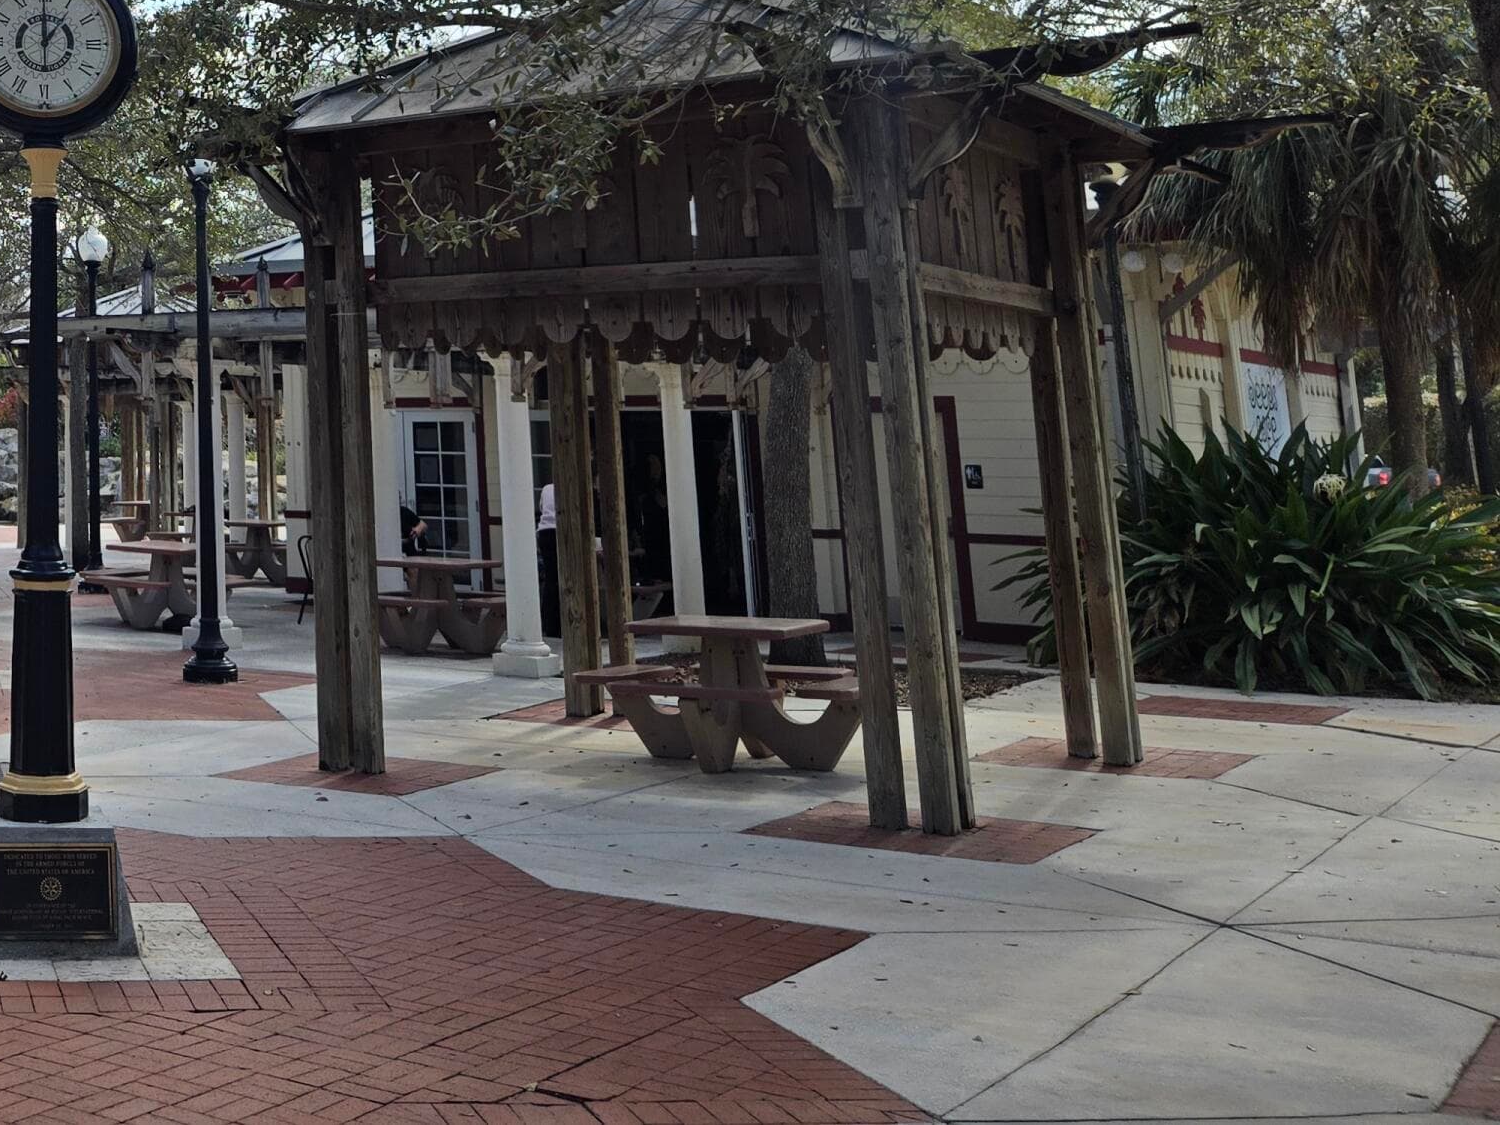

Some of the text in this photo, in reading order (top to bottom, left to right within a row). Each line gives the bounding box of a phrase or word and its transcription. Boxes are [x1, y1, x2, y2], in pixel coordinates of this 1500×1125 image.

[30, 14, 59, 24] ROARY
[80, 13, 95, 25] II
[86, 39, 102, 50] III
[39, 84, 49, 100] VI
